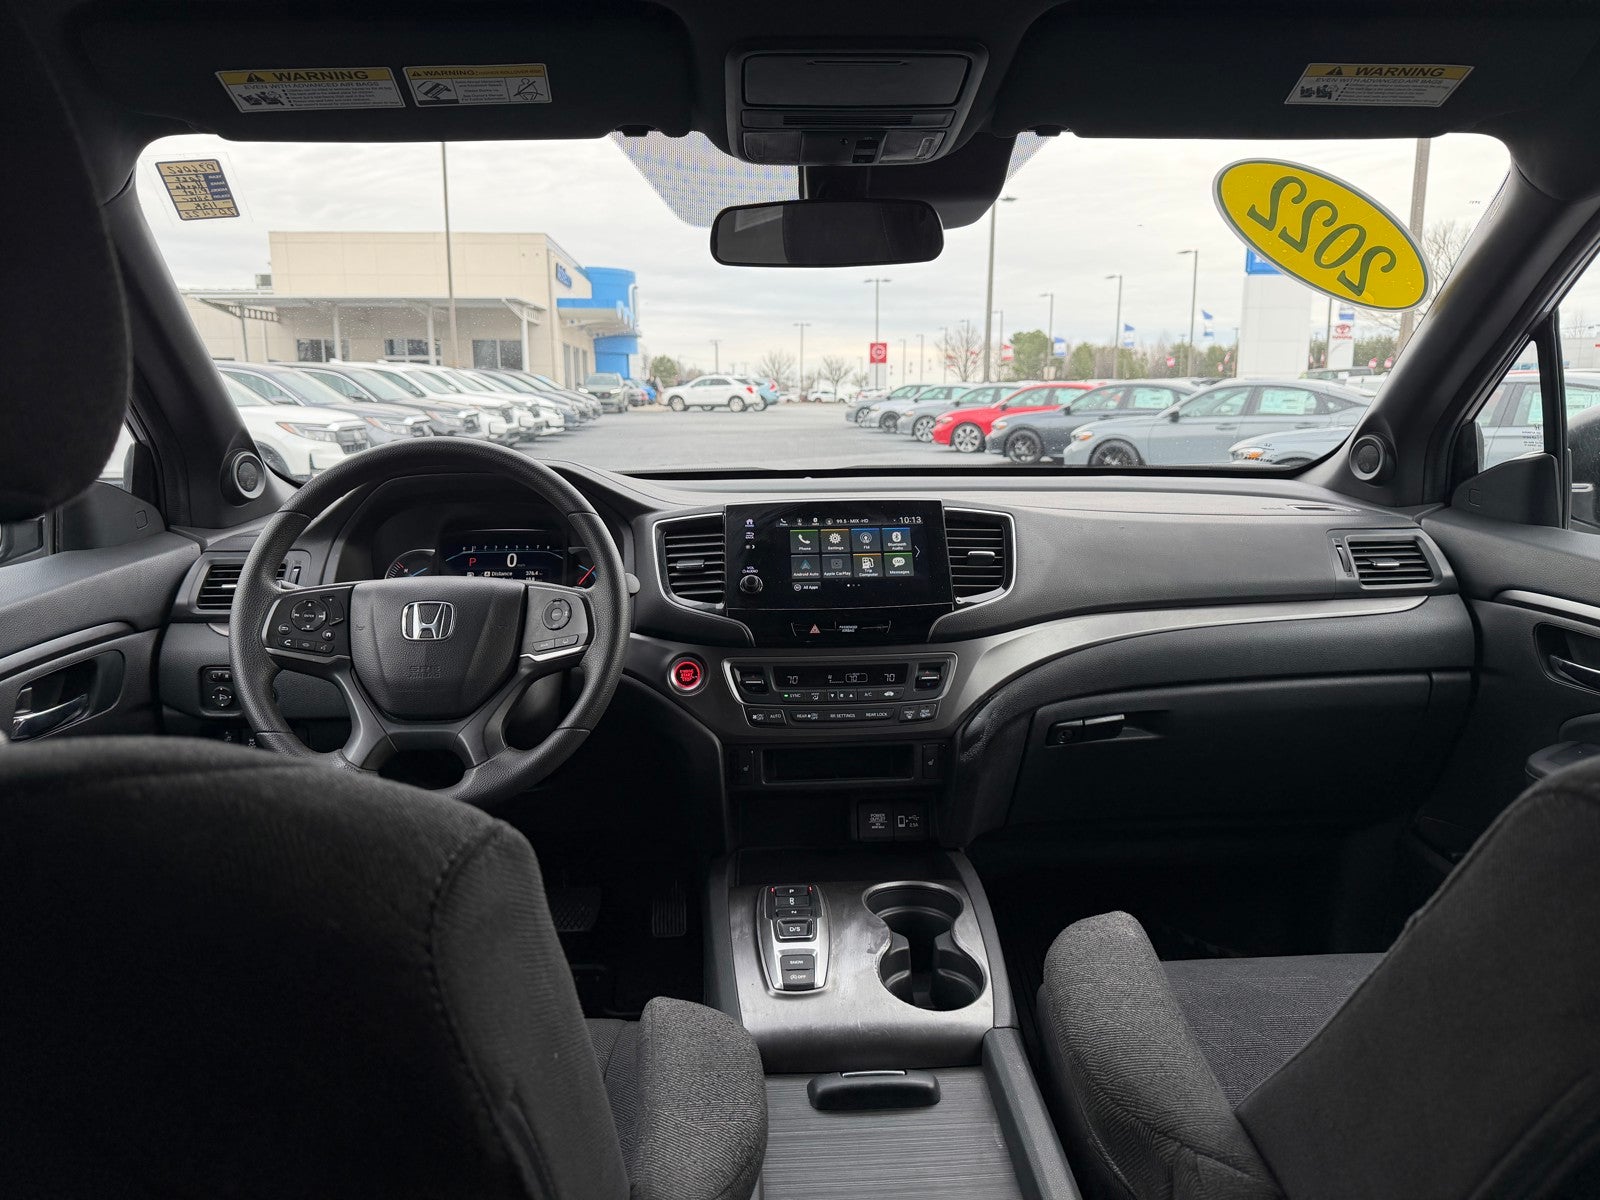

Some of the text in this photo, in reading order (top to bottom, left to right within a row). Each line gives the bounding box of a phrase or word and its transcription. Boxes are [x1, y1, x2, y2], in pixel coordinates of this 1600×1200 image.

[272, 70, 369, 81] WARNING
[1355, 67, 1445, 77] WARNING
[899, 516, 921, 524] 10:13
[469, 557, 477, 567] P
[507, 553, 517, 567] 0
[787, 676, 798, 684] 70
[884, 673, 895, 682] 70
